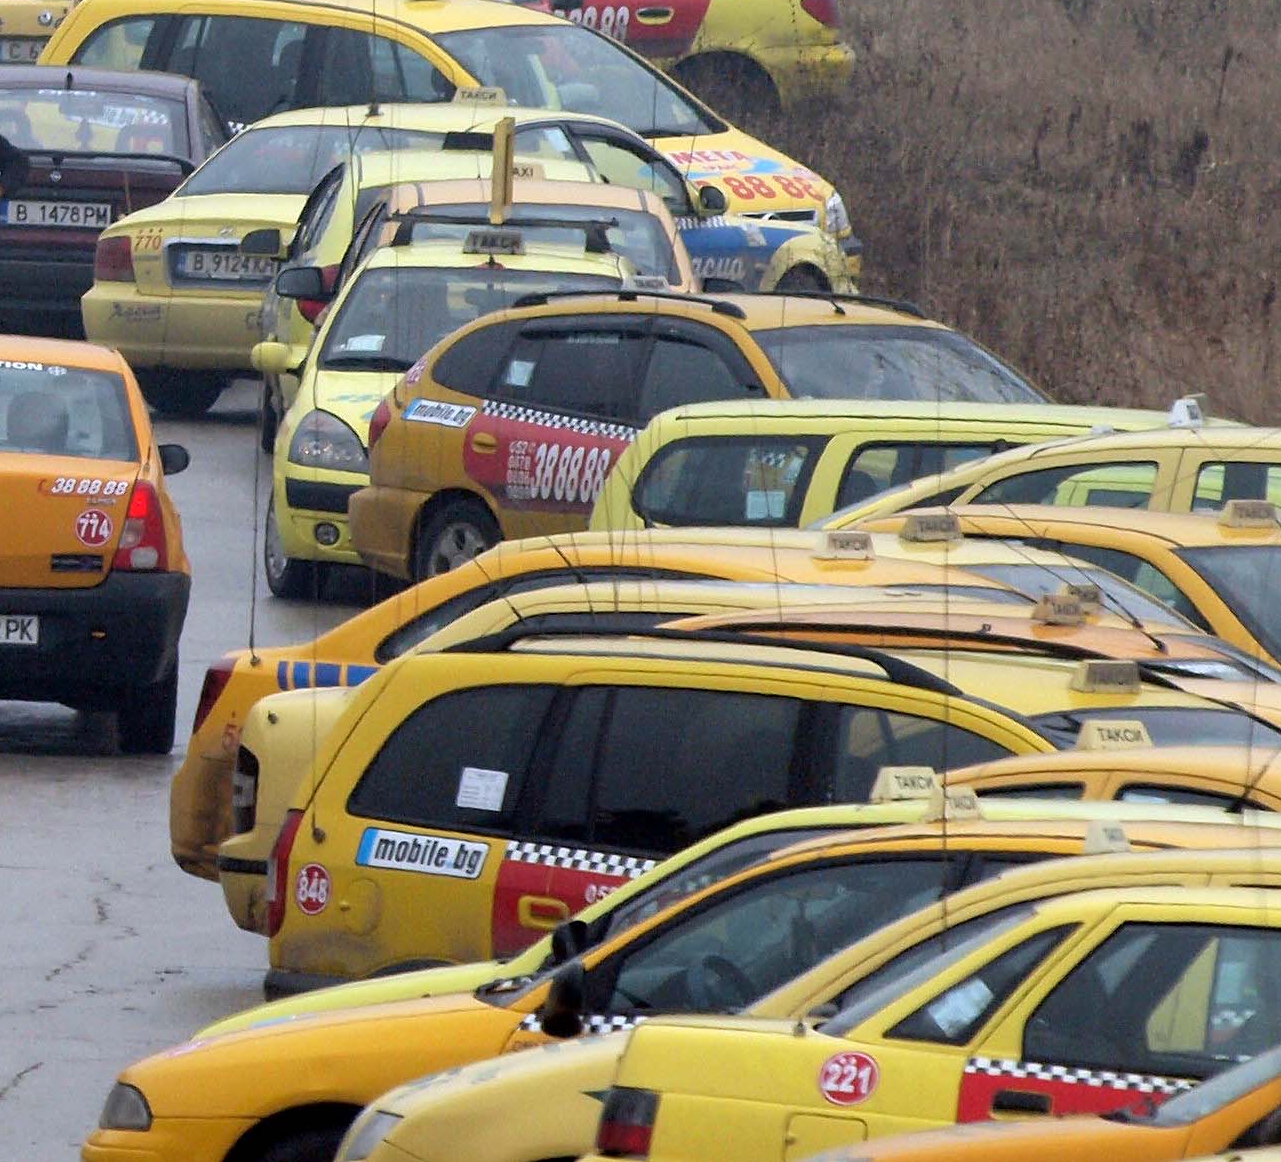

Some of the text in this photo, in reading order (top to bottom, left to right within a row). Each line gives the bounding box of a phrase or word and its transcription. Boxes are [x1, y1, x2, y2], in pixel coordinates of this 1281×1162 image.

[668, 151, 750, 164] МЕГА
[512, 167, 534, 177] AXI
[78, 515, 110, 538] 774
[1097, 727, 1145, 742] ТАКСИ
[374, 836, 486, 875] mobile.bg
[820, 1062, 872, 1095] 221
